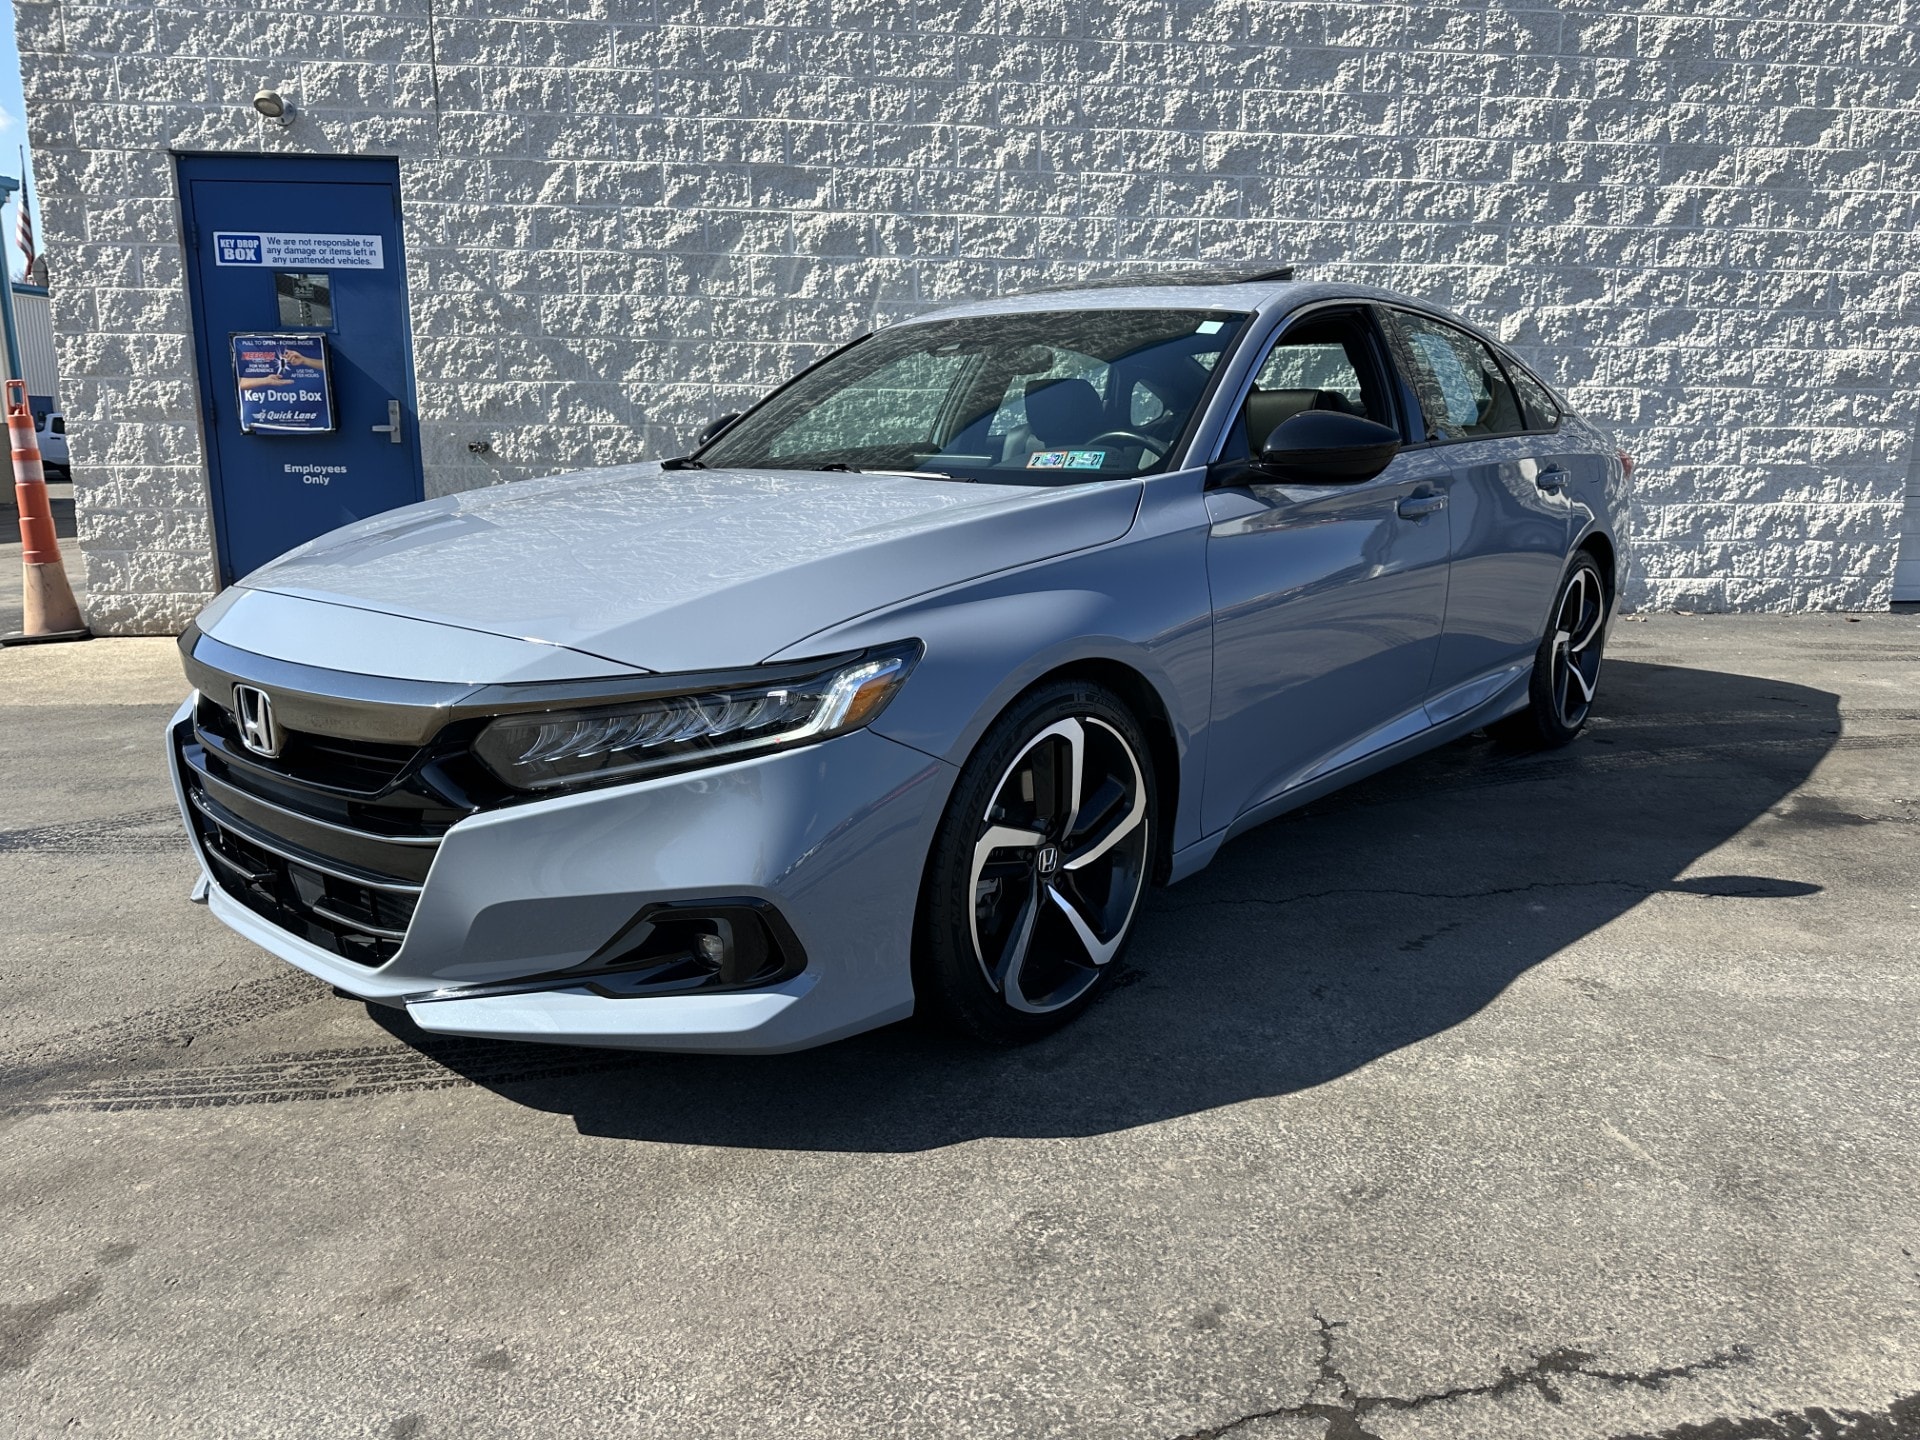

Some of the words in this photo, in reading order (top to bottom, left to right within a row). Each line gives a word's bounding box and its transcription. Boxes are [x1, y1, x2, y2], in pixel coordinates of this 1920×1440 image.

[220, 239, 235, 248] KEY
[236, 239, 259, 249] DROP
[266, 236, 281, 246] We
[298, 238, 312, 246] not
[313, 238, 361, 248] responsible
[362, 238, 375, 247] for
[223, 248, 257, 261] BOX
[266, 248, 281, 256] any
[284, 246, 317, 257] damage
[329, 247, 352, 256] items
[353, 247, 367, 256] left
[369, 247, 377, 256] in
[272, 257, 287, 265] any
[289, 256, 335, 265] unattended
[337, 257, 373, 266] vehicles.
[244, 389, 266, 404] Key
[267, 389, 297, 404] Drop
[299, 389, 322, 402] Box
[267, 410, 293, 420] Quick
[293, 410, 317, 420] Lane
[1067, 456, 1076, 466] 2
[284, 463, 348, 475] Employees
[302, 474, 330, 486] Only
